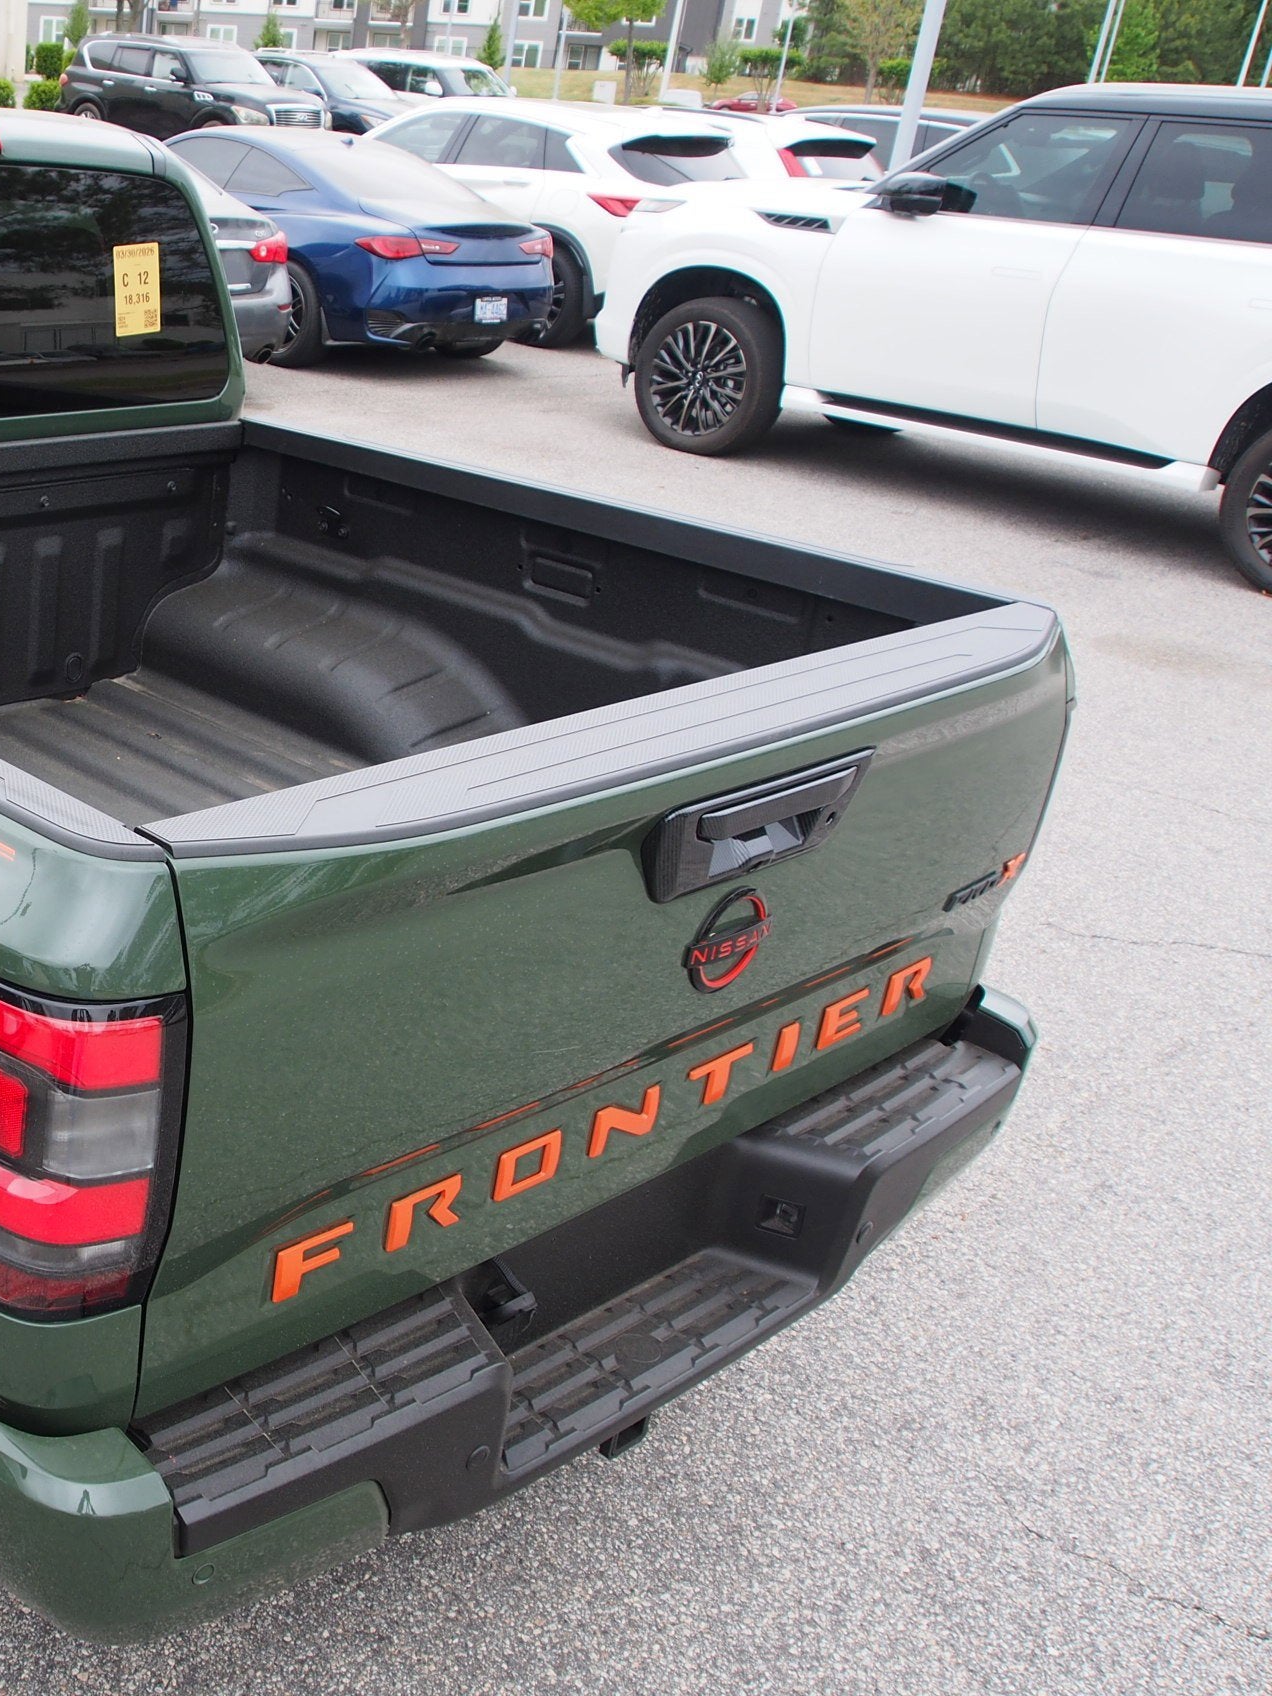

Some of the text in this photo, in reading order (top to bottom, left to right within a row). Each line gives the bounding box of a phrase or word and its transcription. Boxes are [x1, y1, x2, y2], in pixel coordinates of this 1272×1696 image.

[122, 270, 149, 287] C 12
[124, 292, 150, 305] 18,316
[690, 921, 771, 965] NISSAN
[271, 956, 932, 1303] FRONTIER
